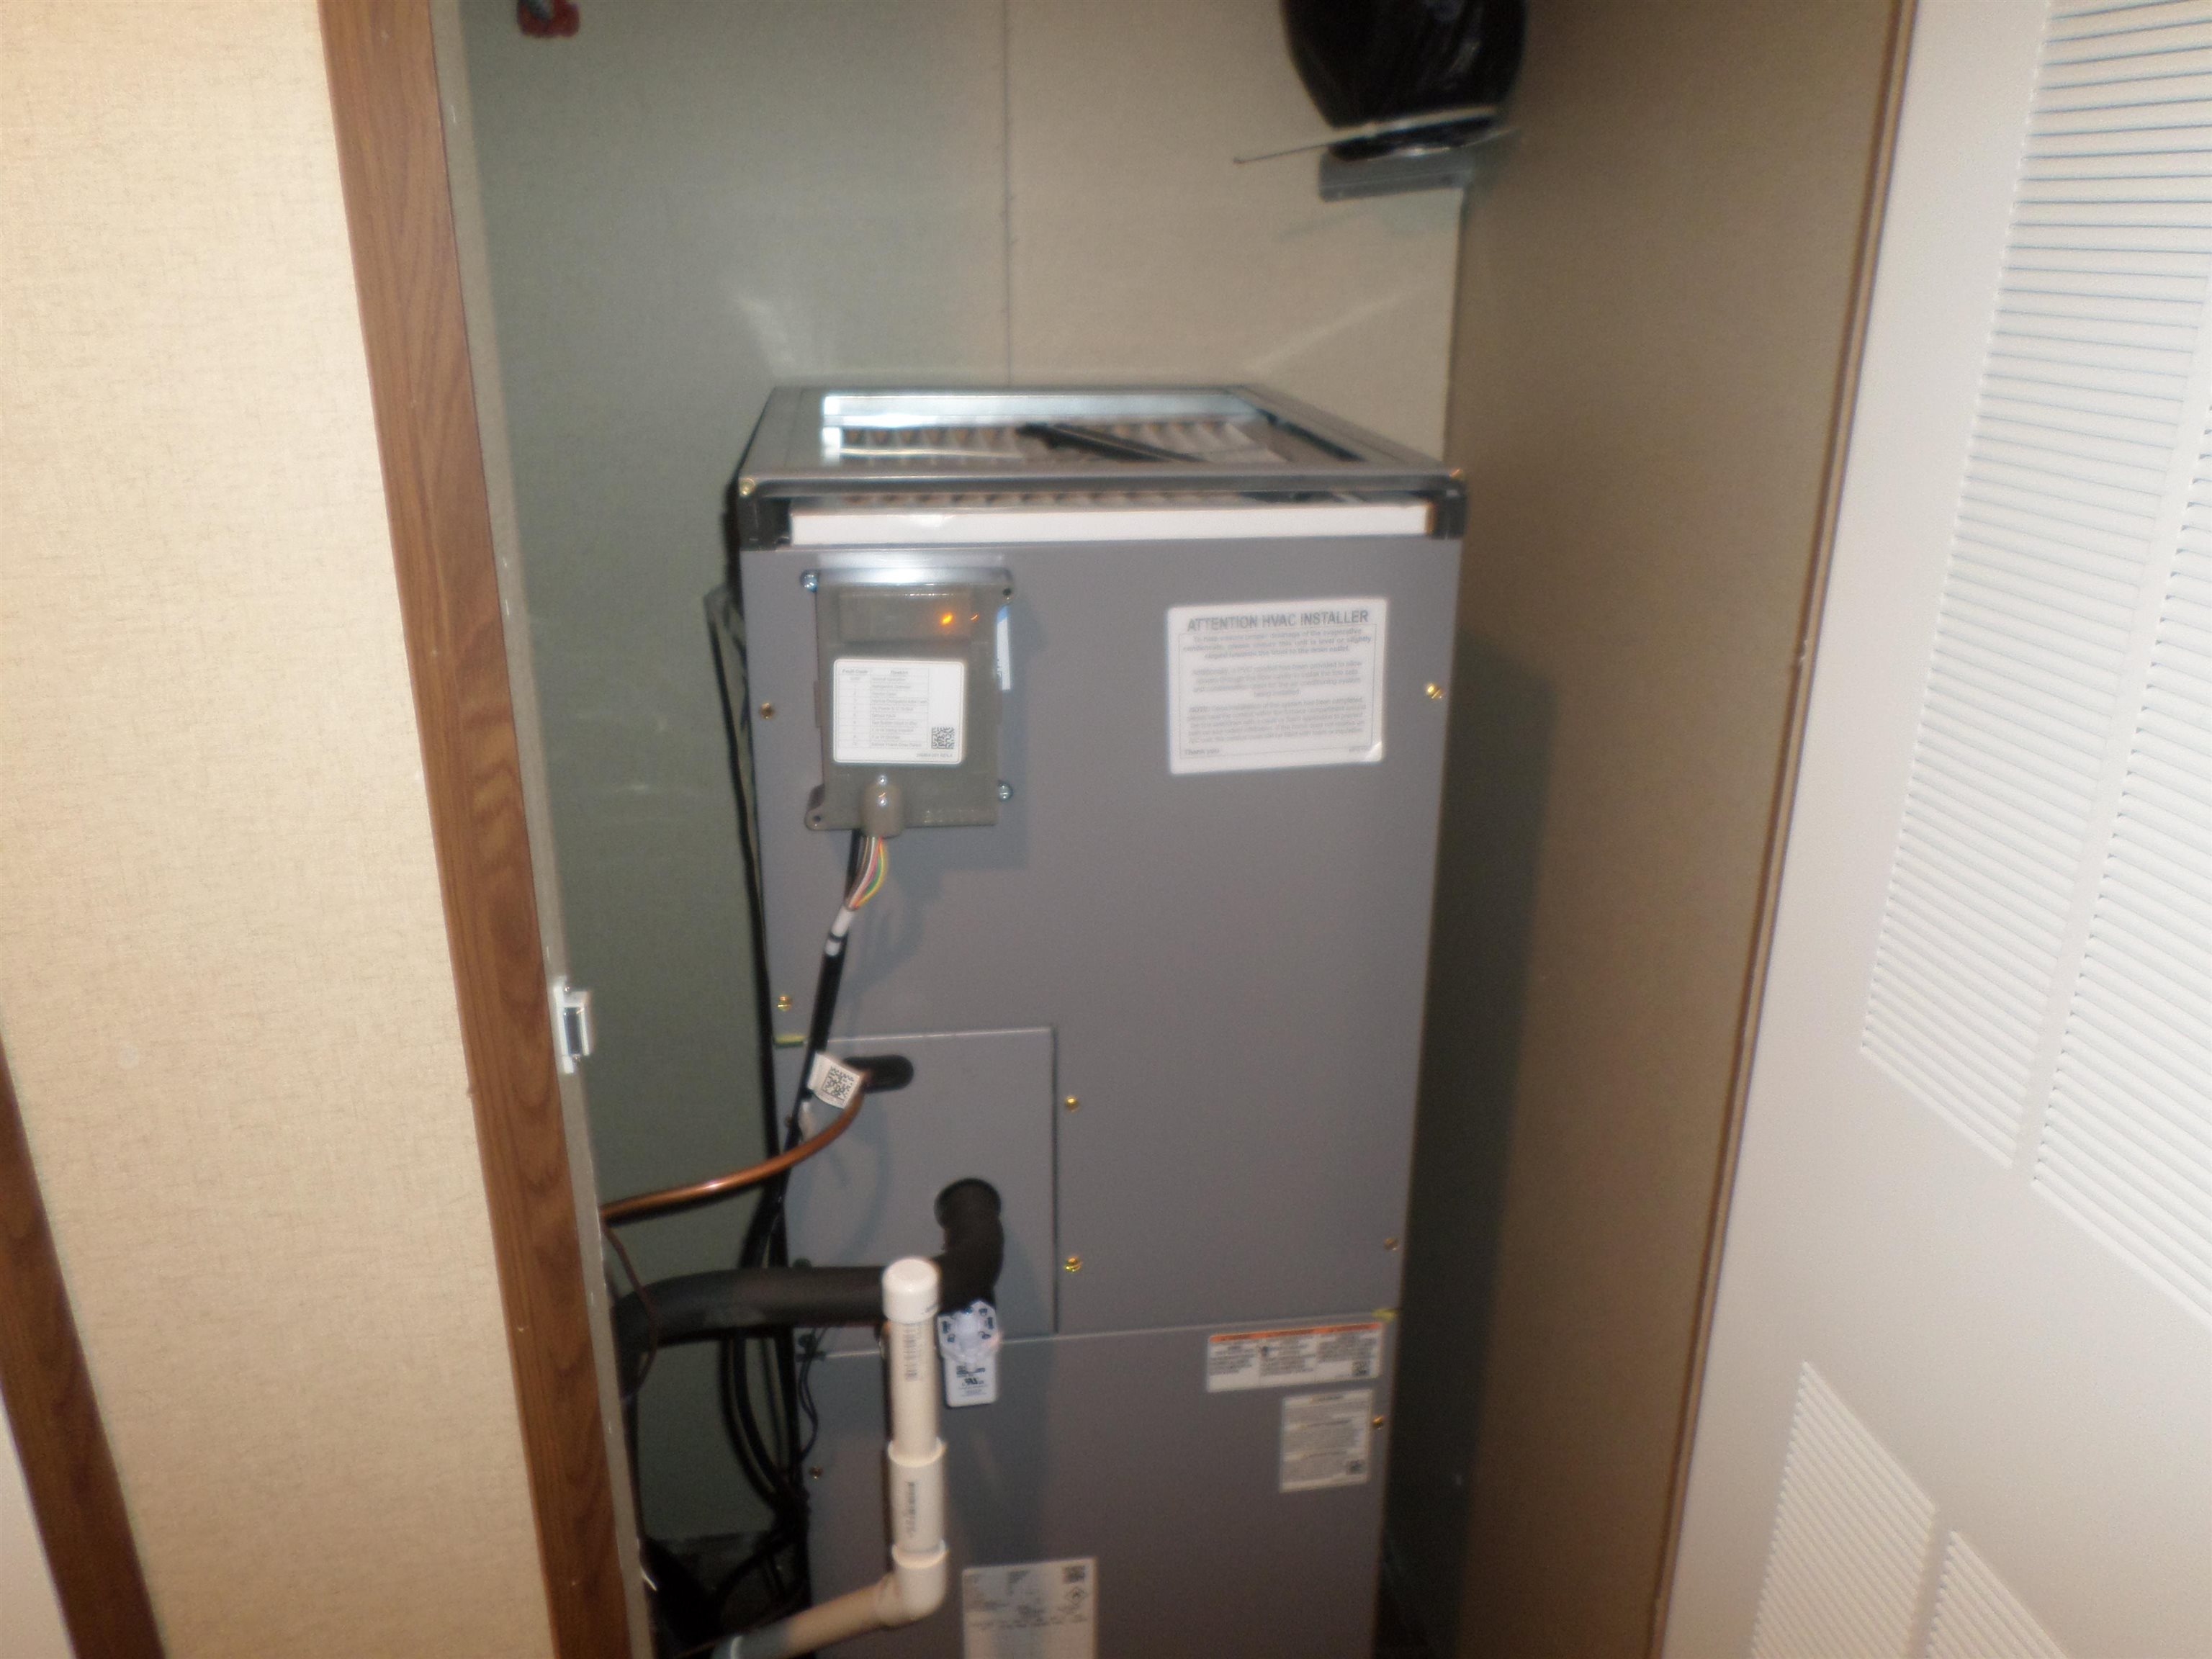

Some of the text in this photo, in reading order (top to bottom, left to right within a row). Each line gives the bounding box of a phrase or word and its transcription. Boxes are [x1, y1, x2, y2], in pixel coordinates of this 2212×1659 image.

[1187, 610, 1369, 631] ATTENTION HVAC INSTALLER
